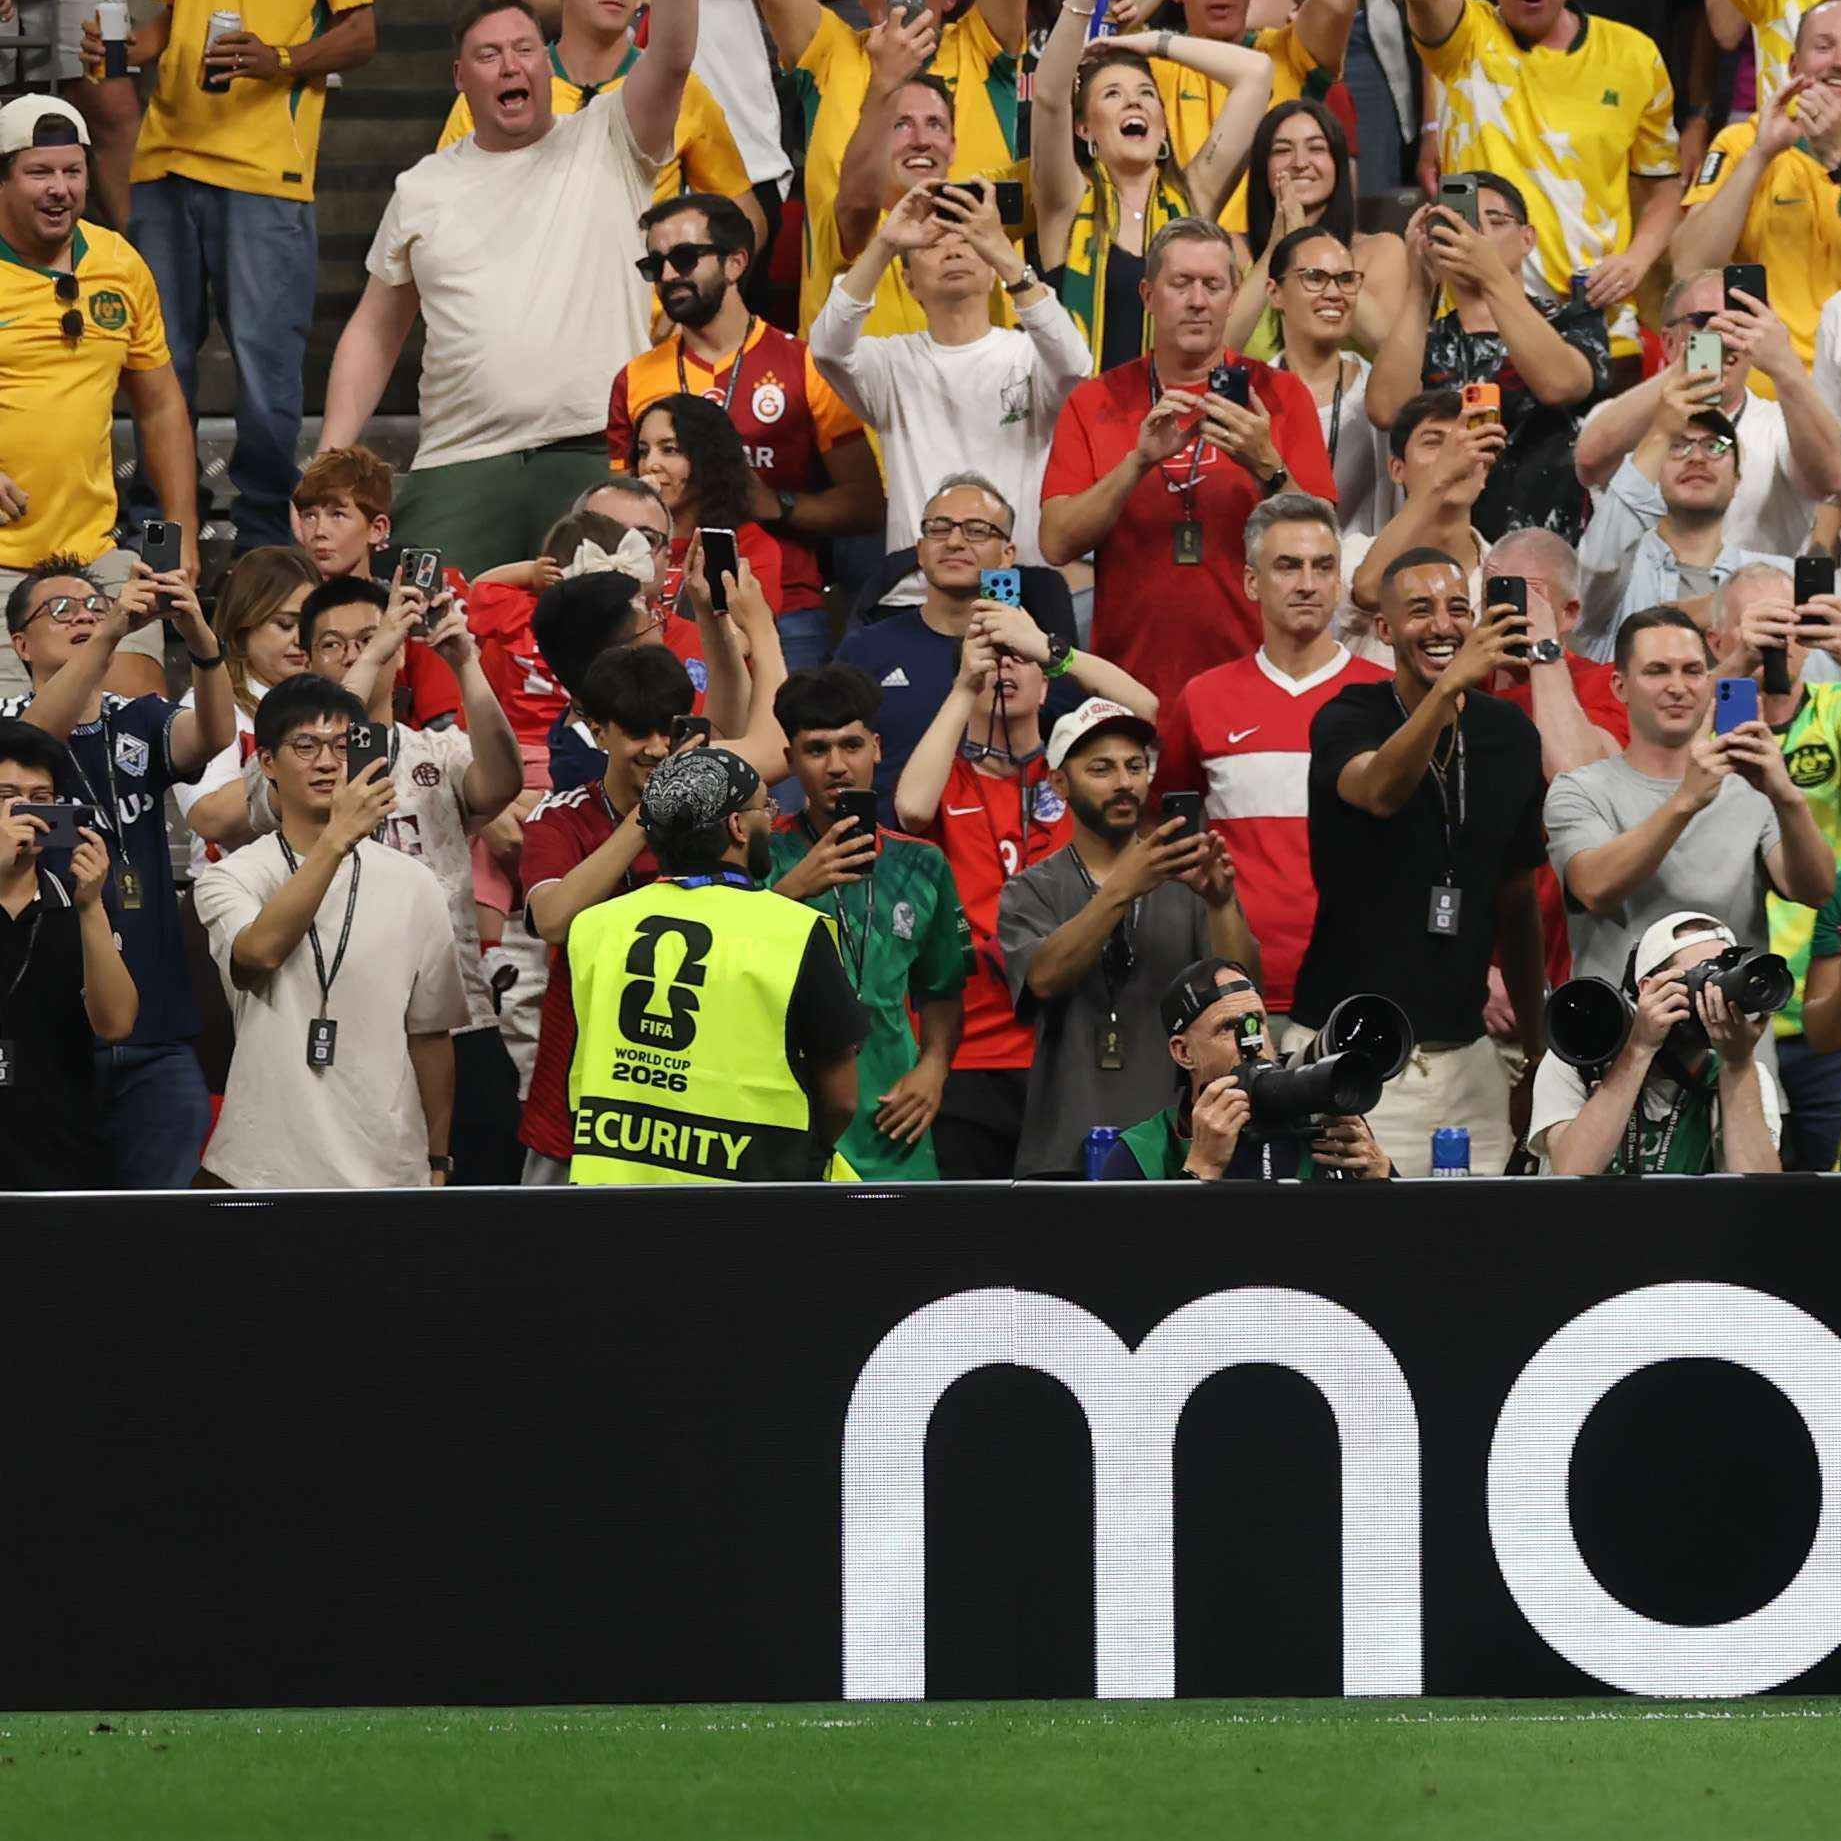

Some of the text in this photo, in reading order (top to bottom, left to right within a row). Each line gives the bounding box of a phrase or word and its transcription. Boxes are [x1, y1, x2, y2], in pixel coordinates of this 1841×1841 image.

[639, 1018, 673, 1039] FIFA
[614, 1046, 691, 1072] WORLD CUP
[611, 1061, 689, 1094] 2026
[573, 1108, 753, 1171] ECURITY
